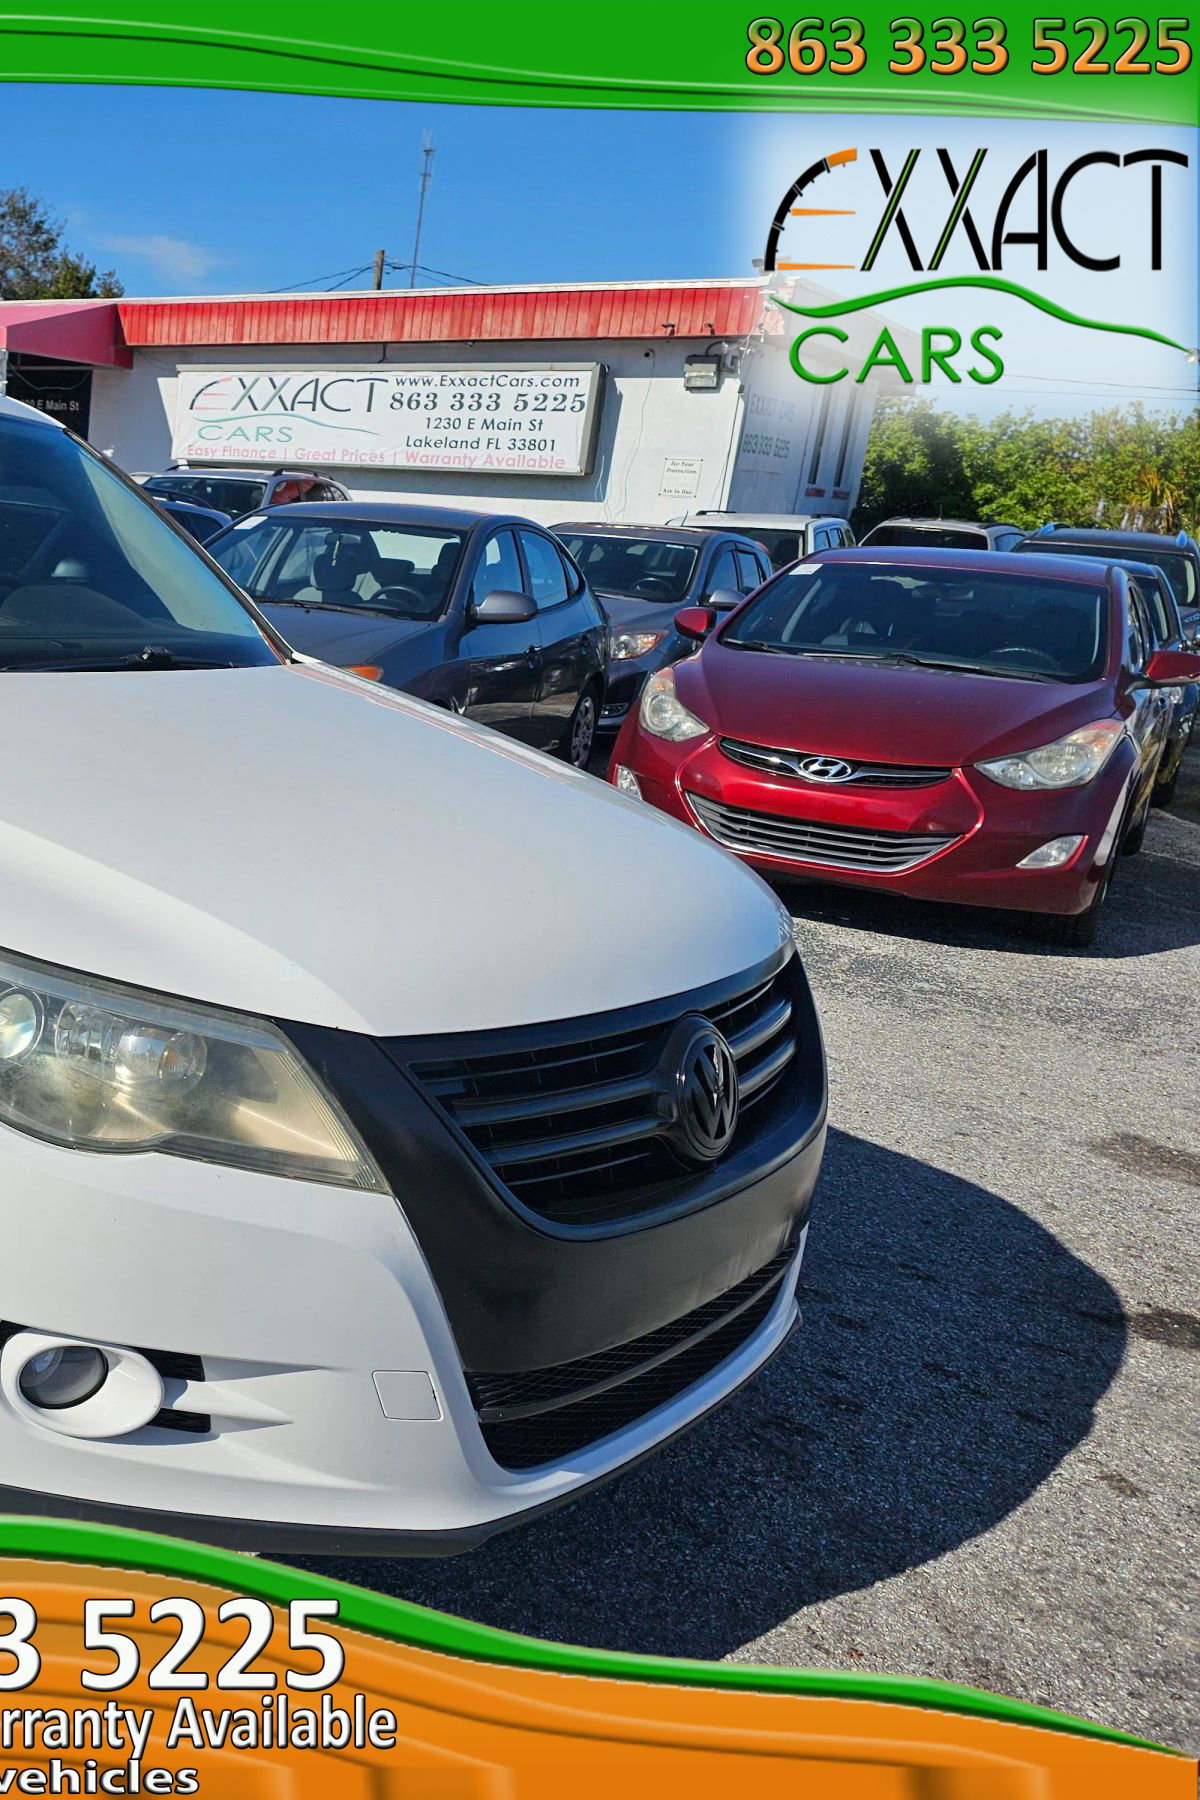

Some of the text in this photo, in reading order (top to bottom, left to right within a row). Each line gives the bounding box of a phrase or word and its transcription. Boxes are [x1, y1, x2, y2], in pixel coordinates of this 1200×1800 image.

[395, 374, 581, 388] www.ExxactCars.com
[189, 376, 389, 413] EXXACT
[389, 391, 586, 413] 863 333 5225
[36, 400, 44, 410] E
[45, 400, 68, 411] Main
[69, 401, 80, 411] St
[425, 417, 544, 432] 1230 E Main St
[197, 425, 293, 443] CARS
[406, 435, 556, 452] Lakeland FL 33801
[187, 444, 565, 469] Easy Finance Great Prices Warranty Available
